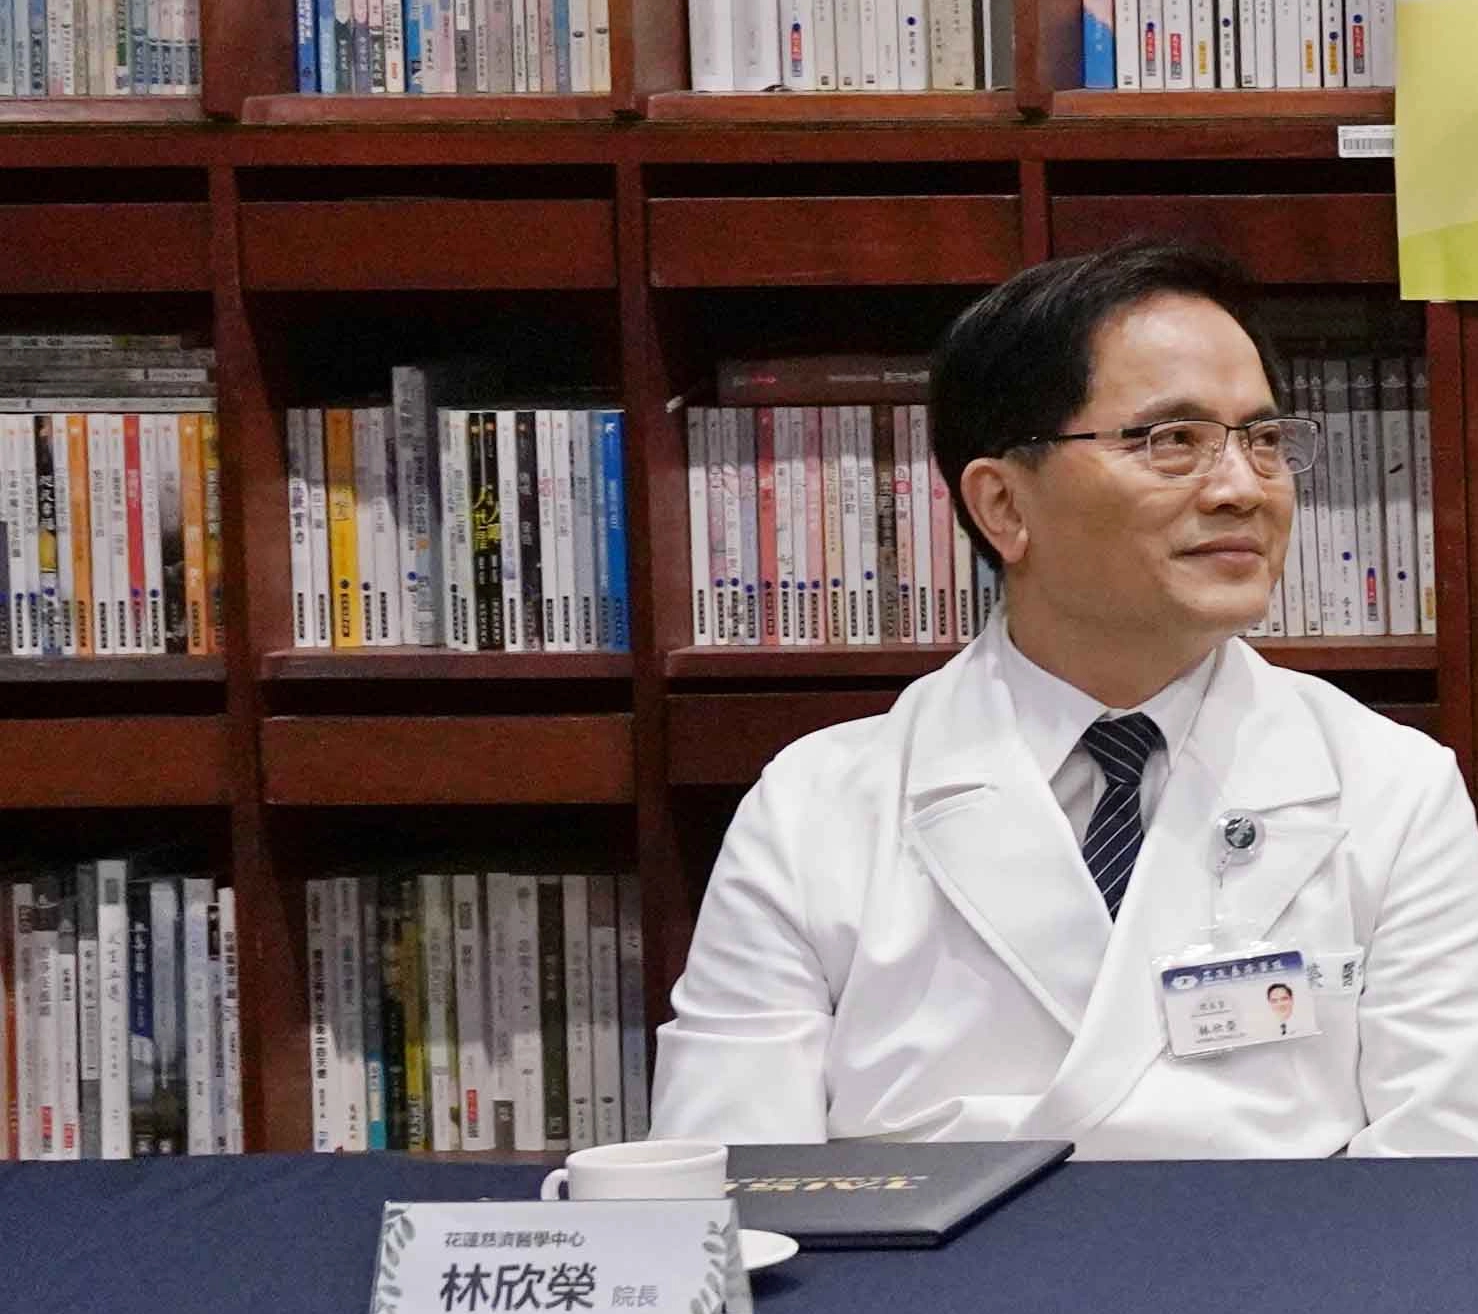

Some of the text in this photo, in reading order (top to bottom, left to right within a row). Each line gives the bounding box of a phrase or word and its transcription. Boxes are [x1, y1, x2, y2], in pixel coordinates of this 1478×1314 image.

[444, 1231, 586, 1249] 花蓮慈濟醫學中心
[440, 1262, 660, 1313] 林欣榮 院長
